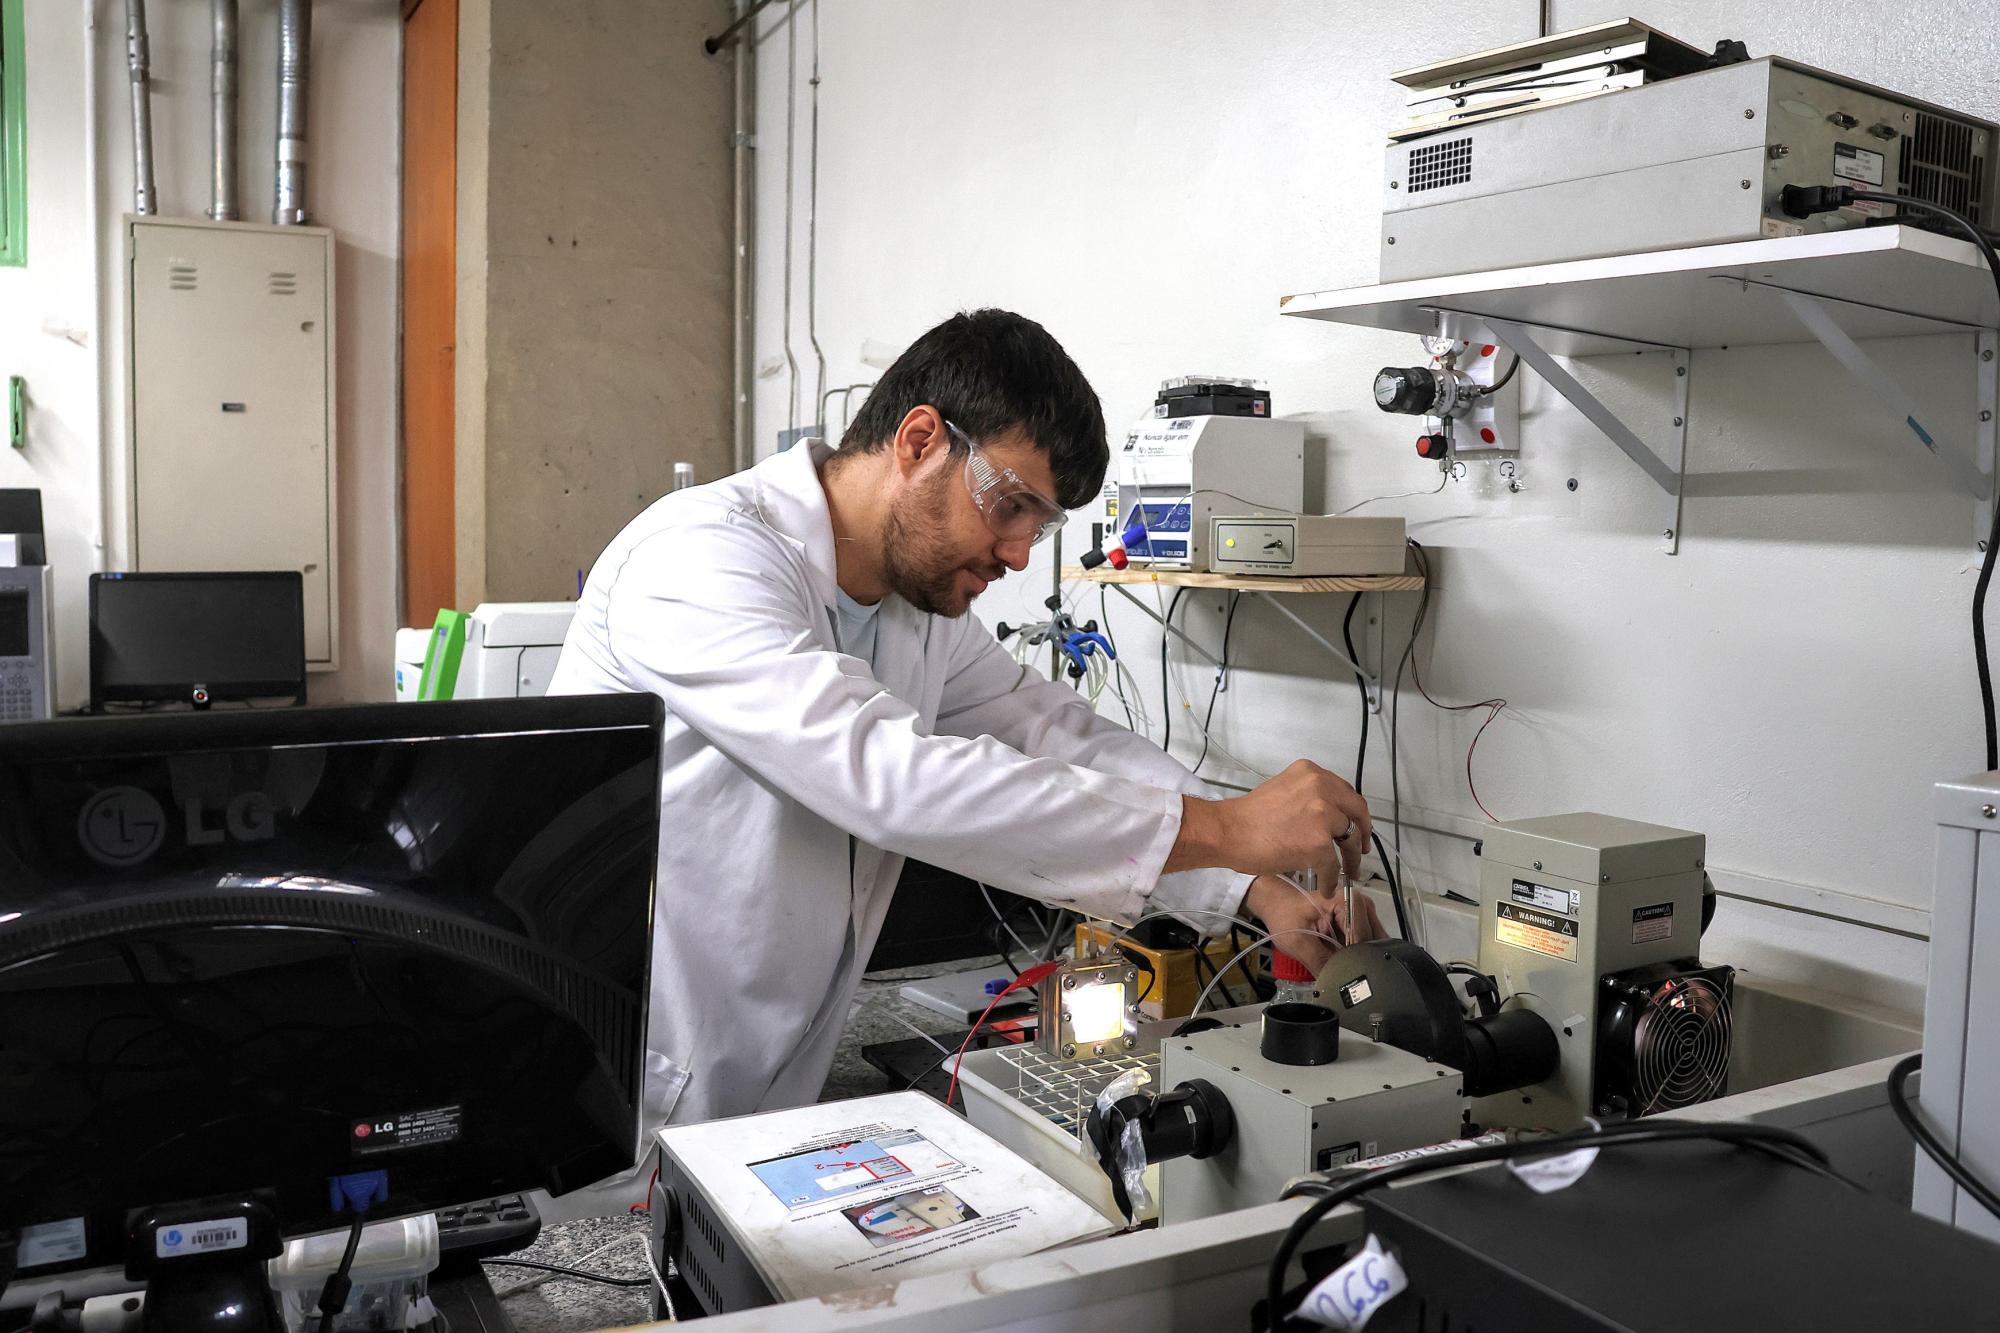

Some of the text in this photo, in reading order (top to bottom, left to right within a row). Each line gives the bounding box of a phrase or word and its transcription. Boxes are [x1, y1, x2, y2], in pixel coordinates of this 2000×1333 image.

[185, 791, 275, 846] LG
[1518, 911, 1555, 928] WARNING!
[374, 1122, 394, 1133] LG
